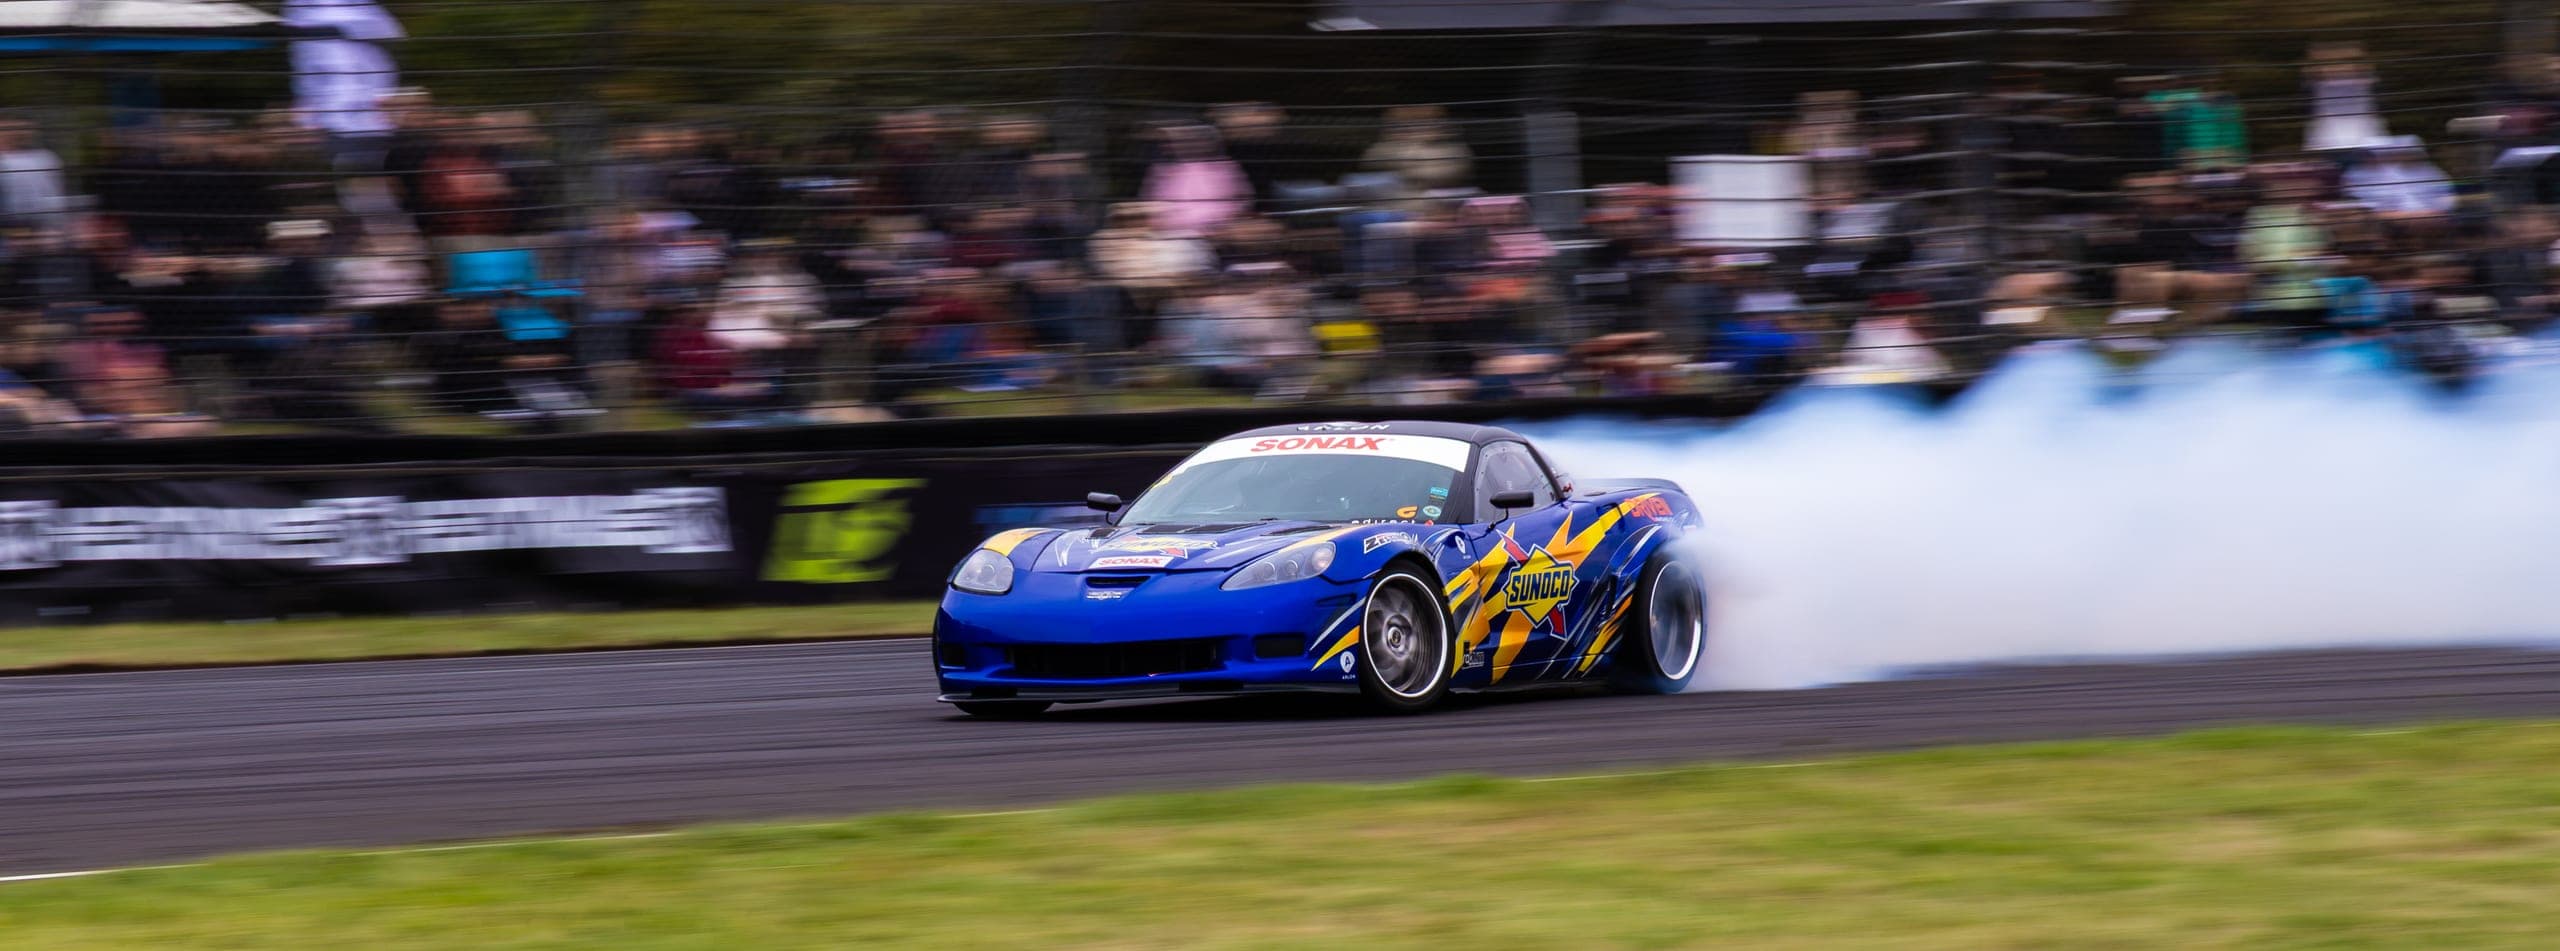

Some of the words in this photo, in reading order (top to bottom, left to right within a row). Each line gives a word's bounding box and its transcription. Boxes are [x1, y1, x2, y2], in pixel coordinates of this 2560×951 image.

[1250, 437, 1386, 452] SONAX
[1100, 557, 1163, 566] SONAX
[1510, 569, 1570, 603] SUNOCO
